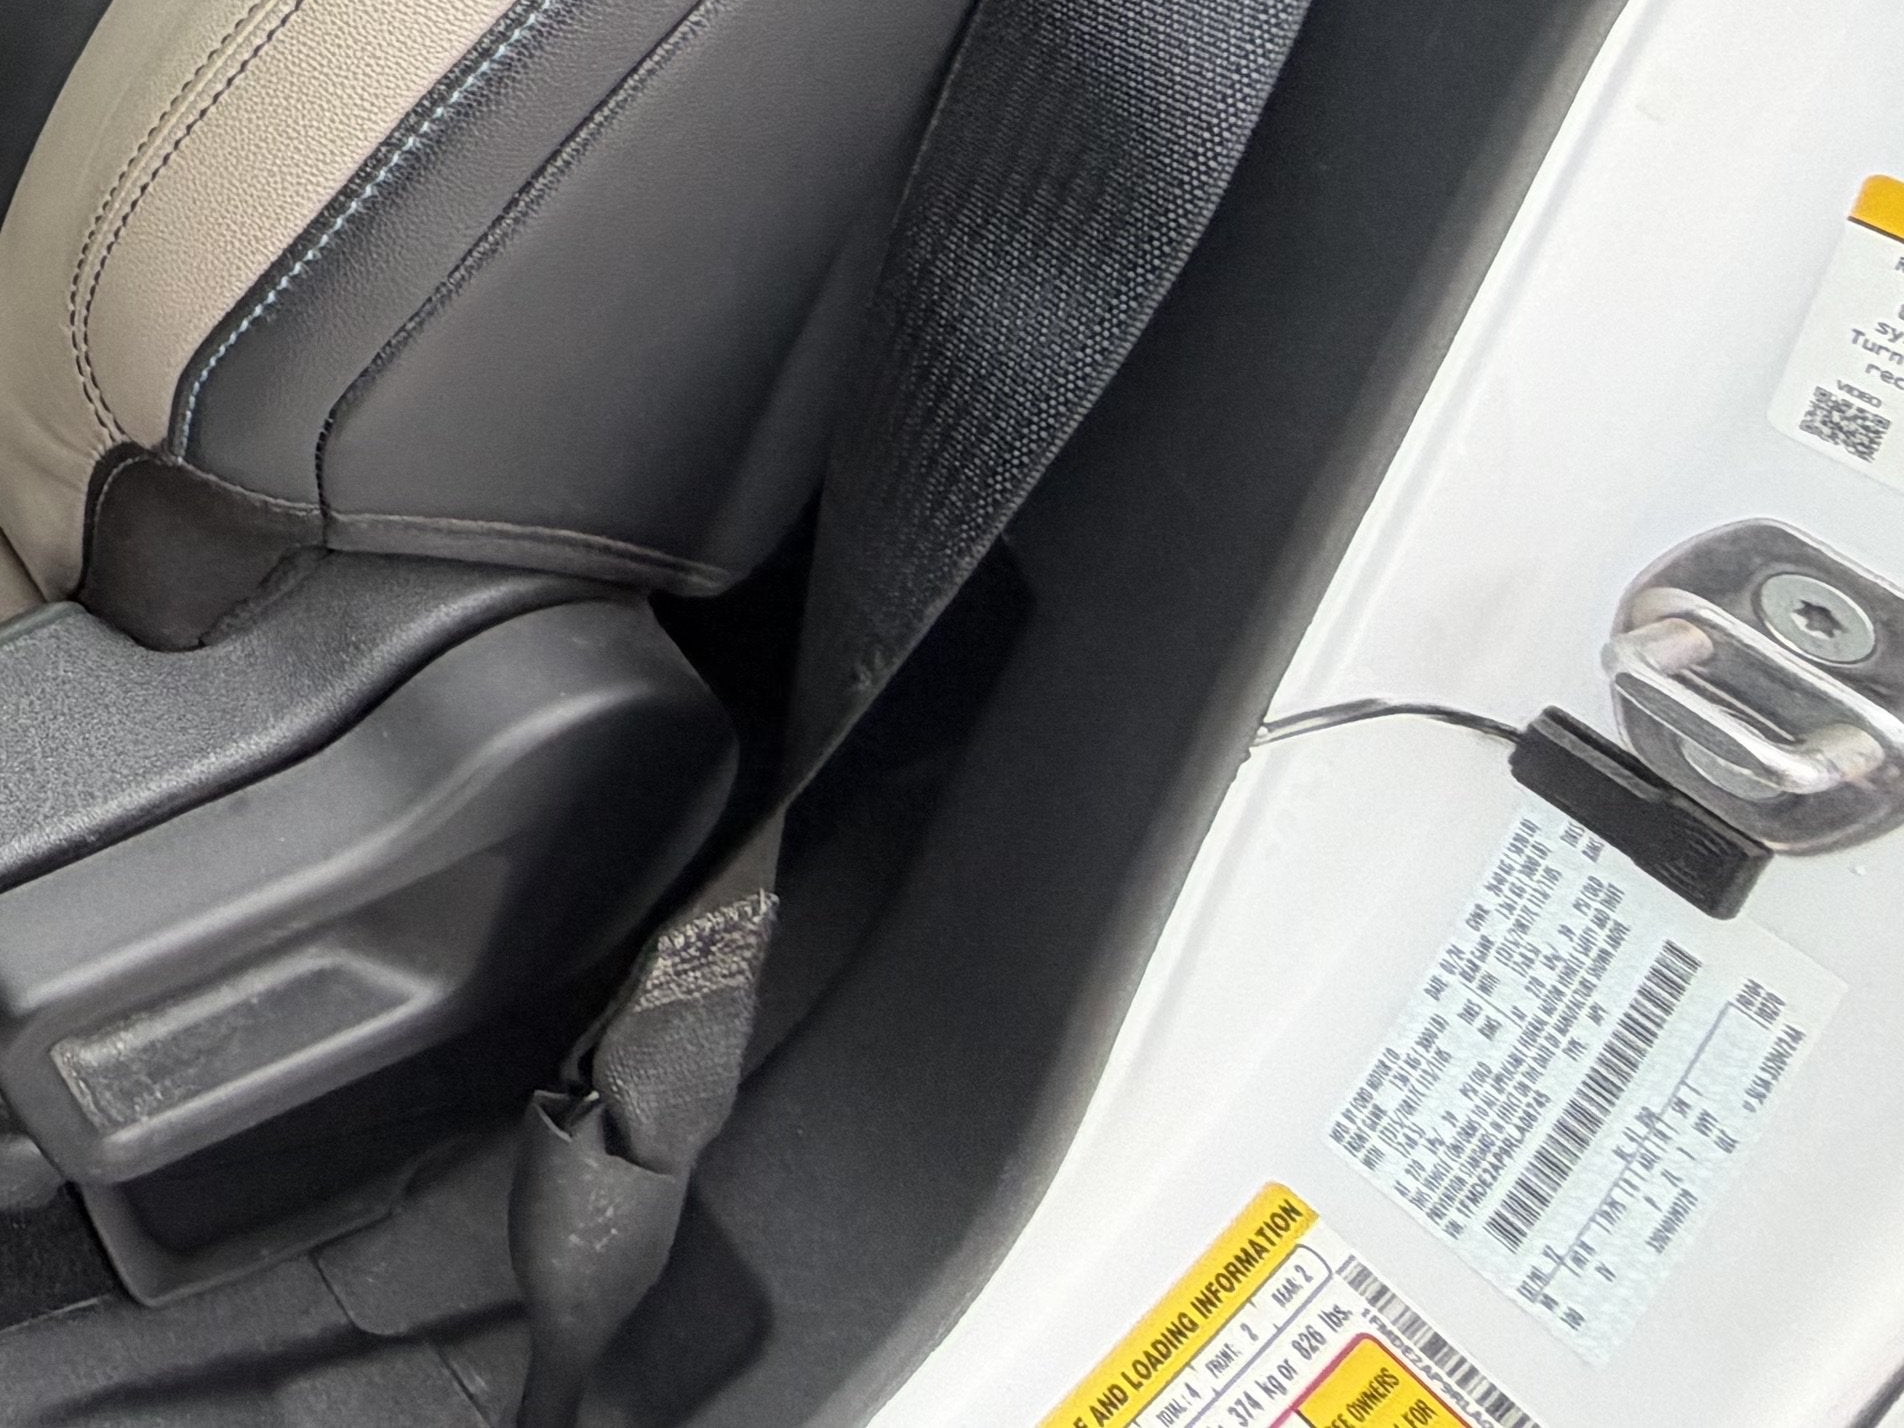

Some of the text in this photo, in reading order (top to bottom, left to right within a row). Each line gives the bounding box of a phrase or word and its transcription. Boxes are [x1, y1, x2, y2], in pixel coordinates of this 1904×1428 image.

[1836, 380, 1882, 408] VIDEO
[1089, 1199, 1304, 1428] AND LOADING INFORMATION
[1227, 1388, 1264, 1428] 374
[1260, 1366, 1289, 1402] kg
[1283, 1354, 1299, 1380] or
[1292, 1324, 1327, 1362] 826
[1346, 1366, 1401, 1423] OWNERS
[1401, 1398, 1438, 1426] FOR
